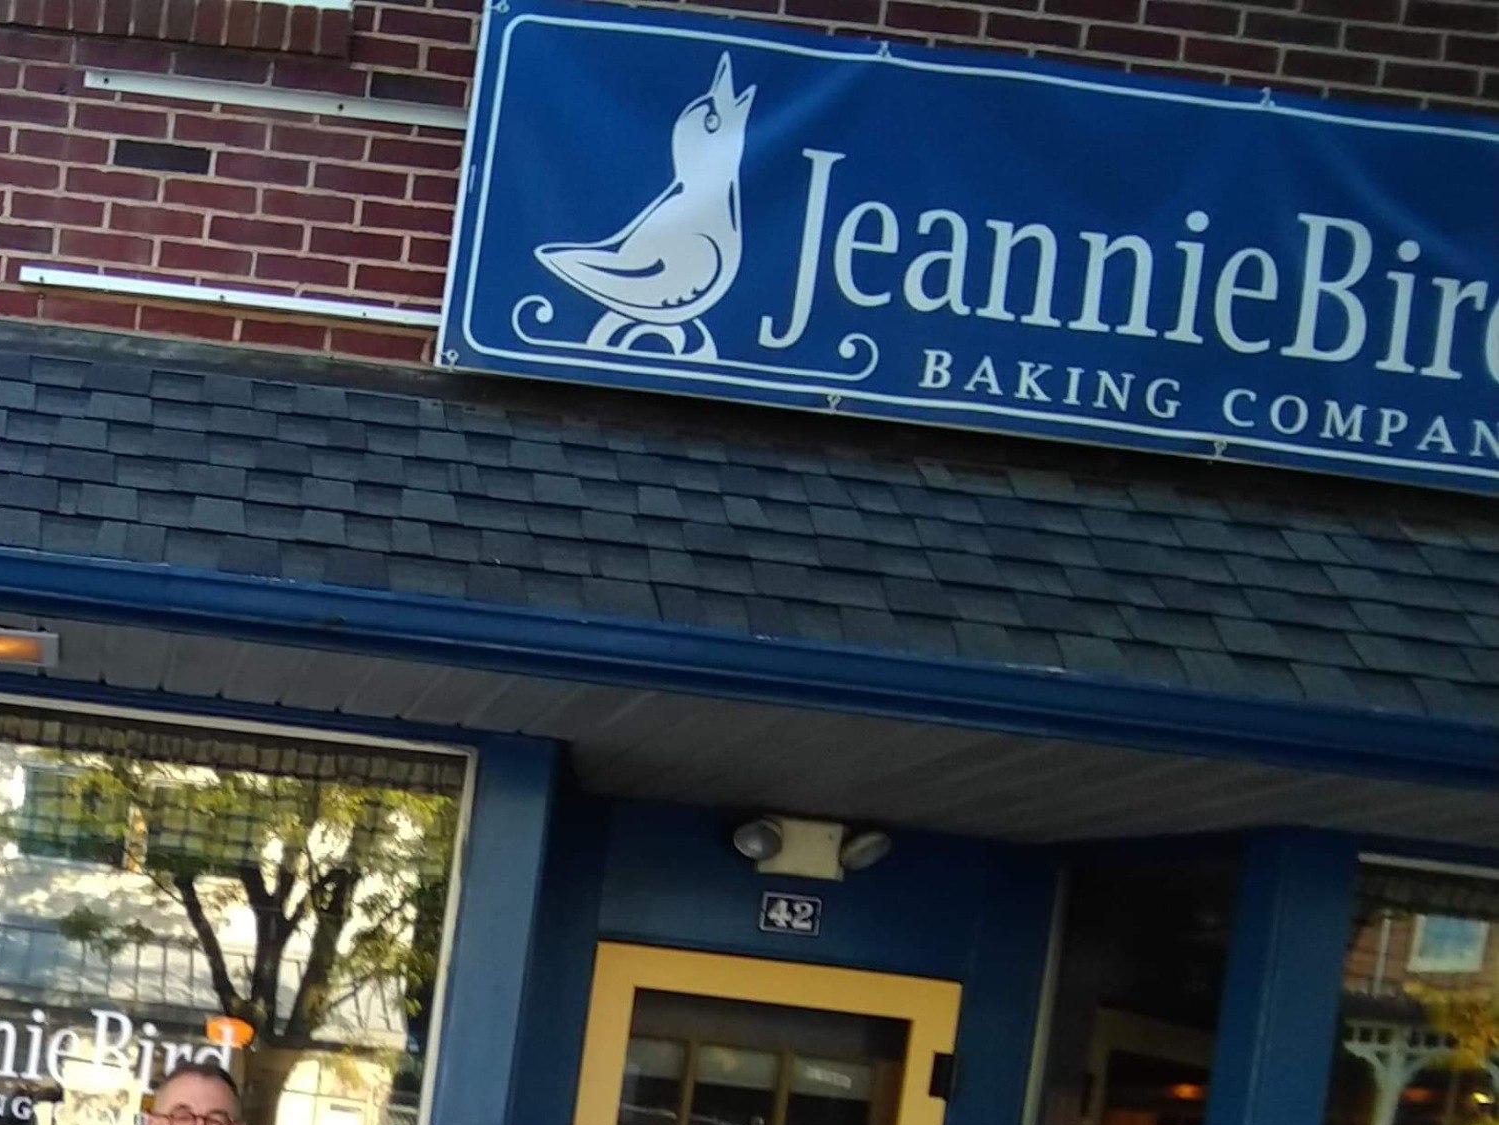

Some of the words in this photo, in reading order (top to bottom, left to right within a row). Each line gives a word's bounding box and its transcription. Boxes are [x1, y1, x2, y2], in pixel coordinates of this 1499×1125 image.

[759, 148, 1499, 386] JeannieBir
[917, 349, 1182, 420] BAKING
[767, 898, 814, 930] 42
